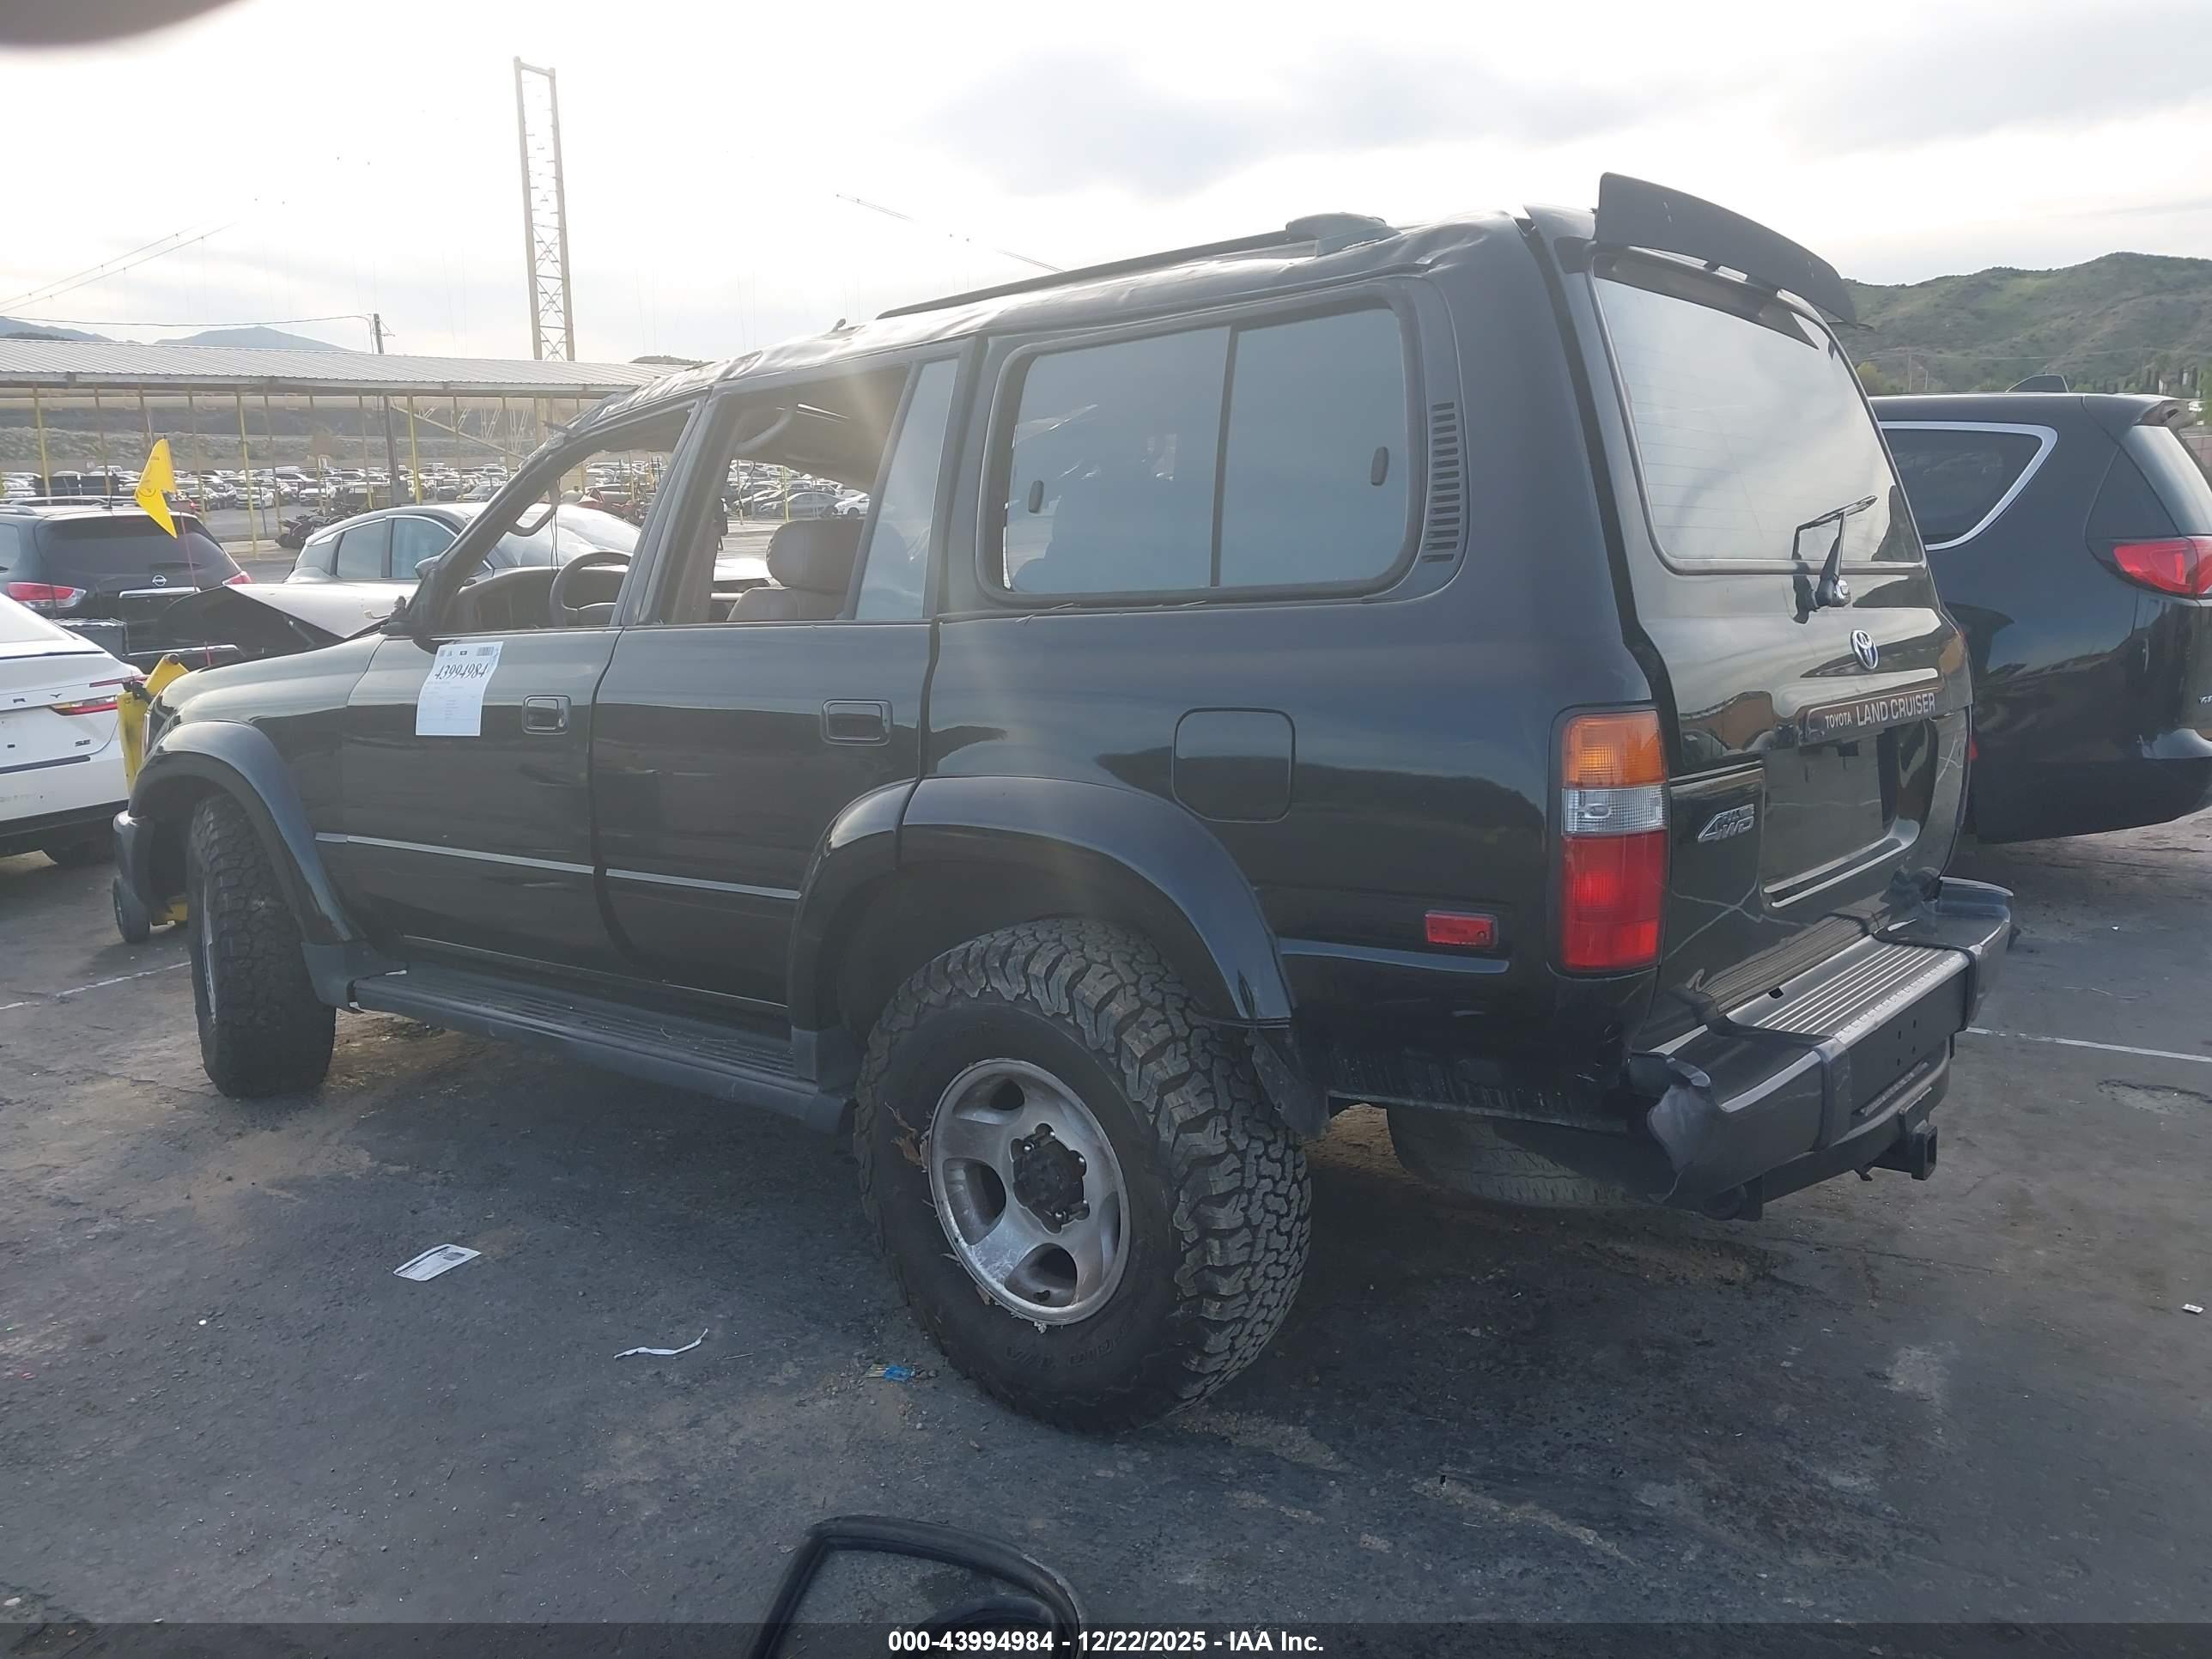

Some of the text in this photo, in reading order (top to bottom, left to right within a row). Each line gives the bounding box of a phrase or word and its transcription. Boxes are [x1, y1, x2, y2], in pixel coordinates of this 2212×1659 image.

[434, 662, 489, 680] 43994984
[1825, 692, 1936, 729] TOYOTA LAND CRUISER
